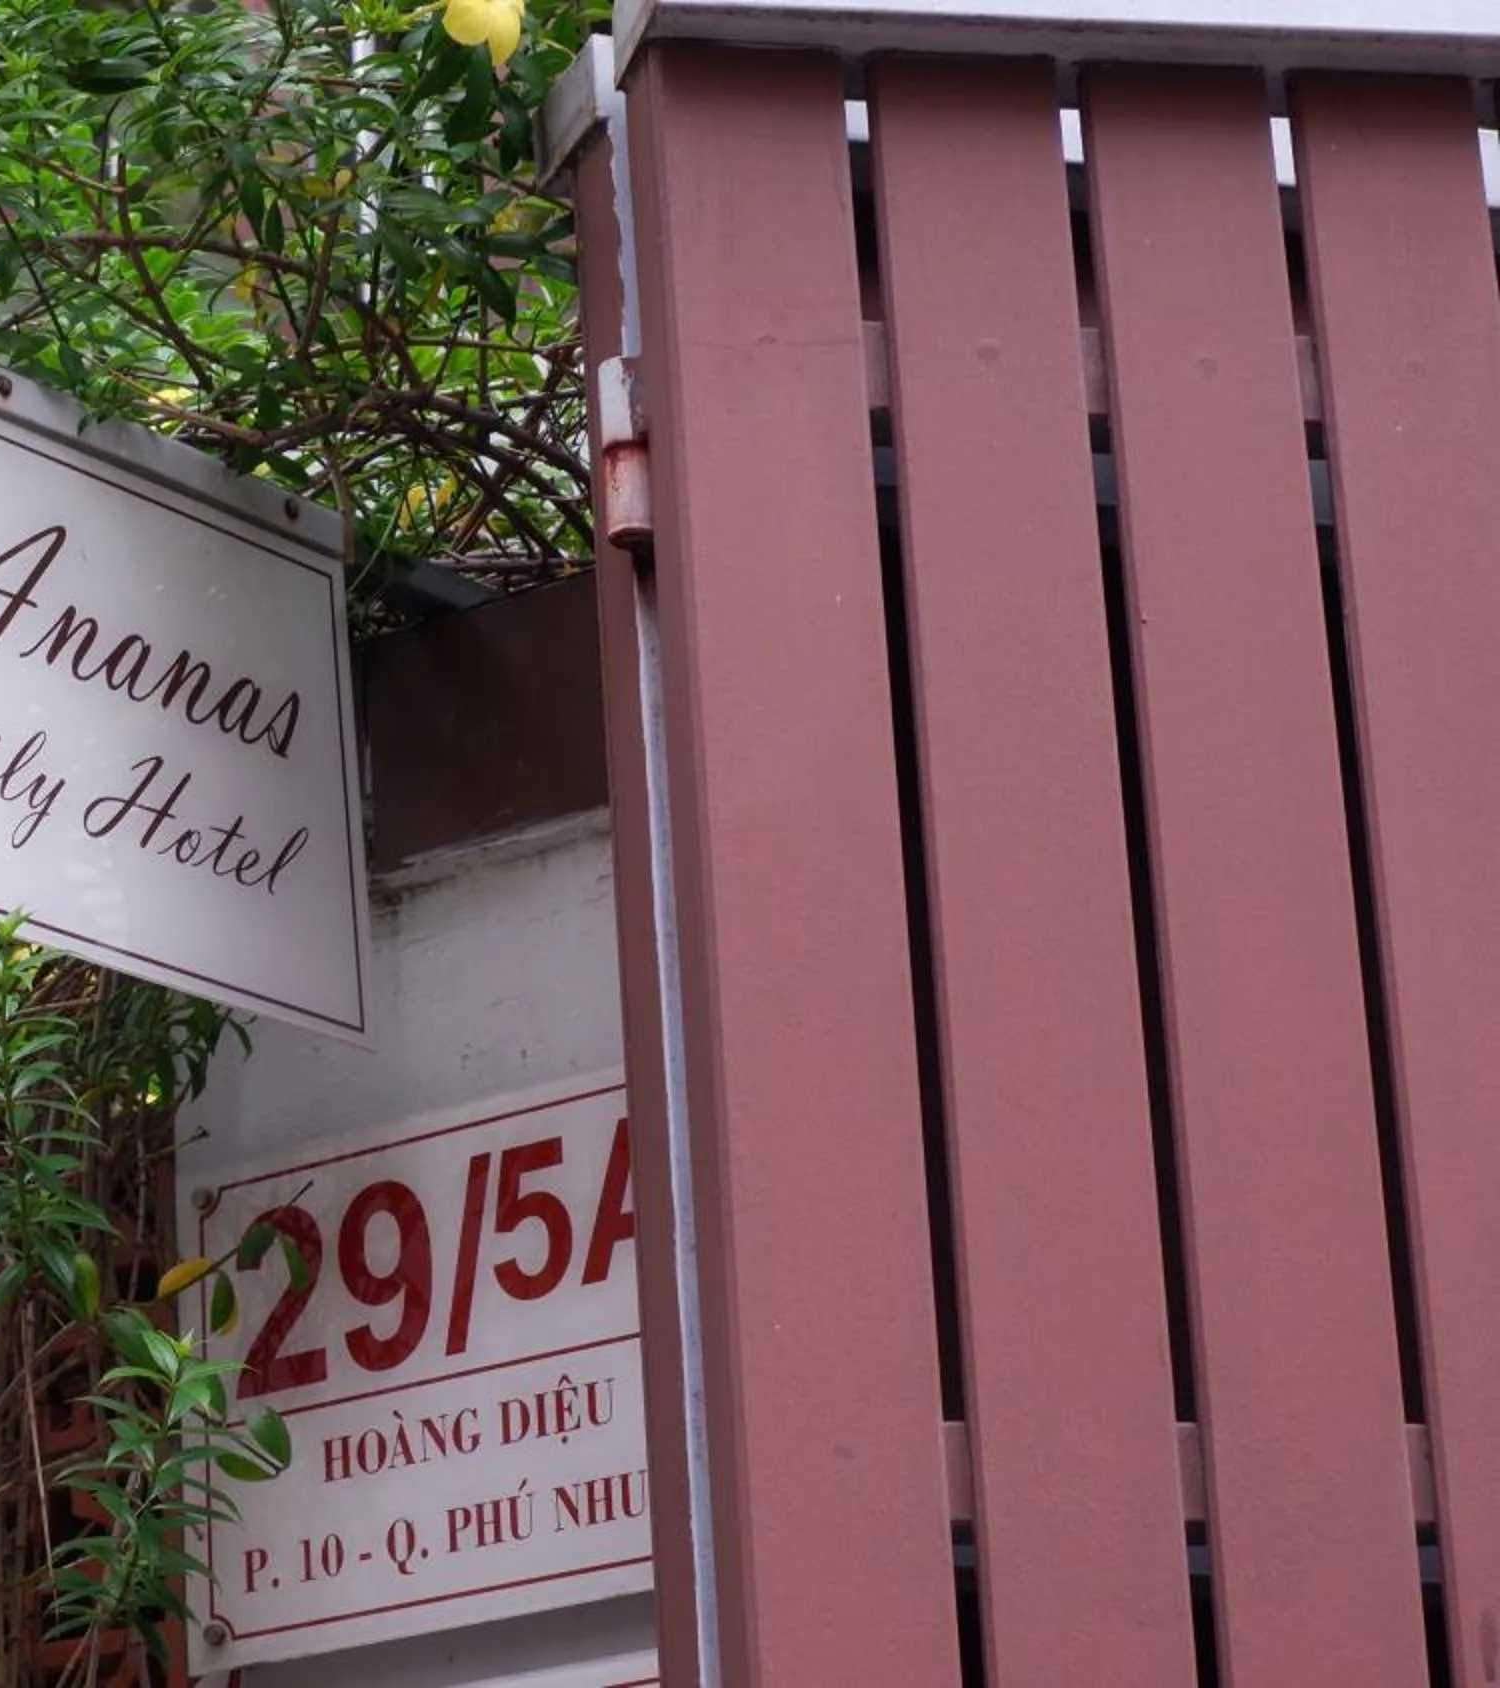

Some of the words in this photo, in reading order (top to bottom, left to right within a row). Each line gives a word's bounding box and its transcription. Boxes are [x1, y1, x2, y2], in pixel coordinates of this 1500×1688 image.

[84, 756, 307, 895] Hotel
[323, 1408, 481, 1482] HOÀNG
[500, 1374, 615, 1445] DIỆU
[244, 1549, 279, 1593] P.
[301, 1532, 344, 1582] 10
[387, 1518, 428, 1576] Q.
[446, 1480, 536, 1553] PHÚ
